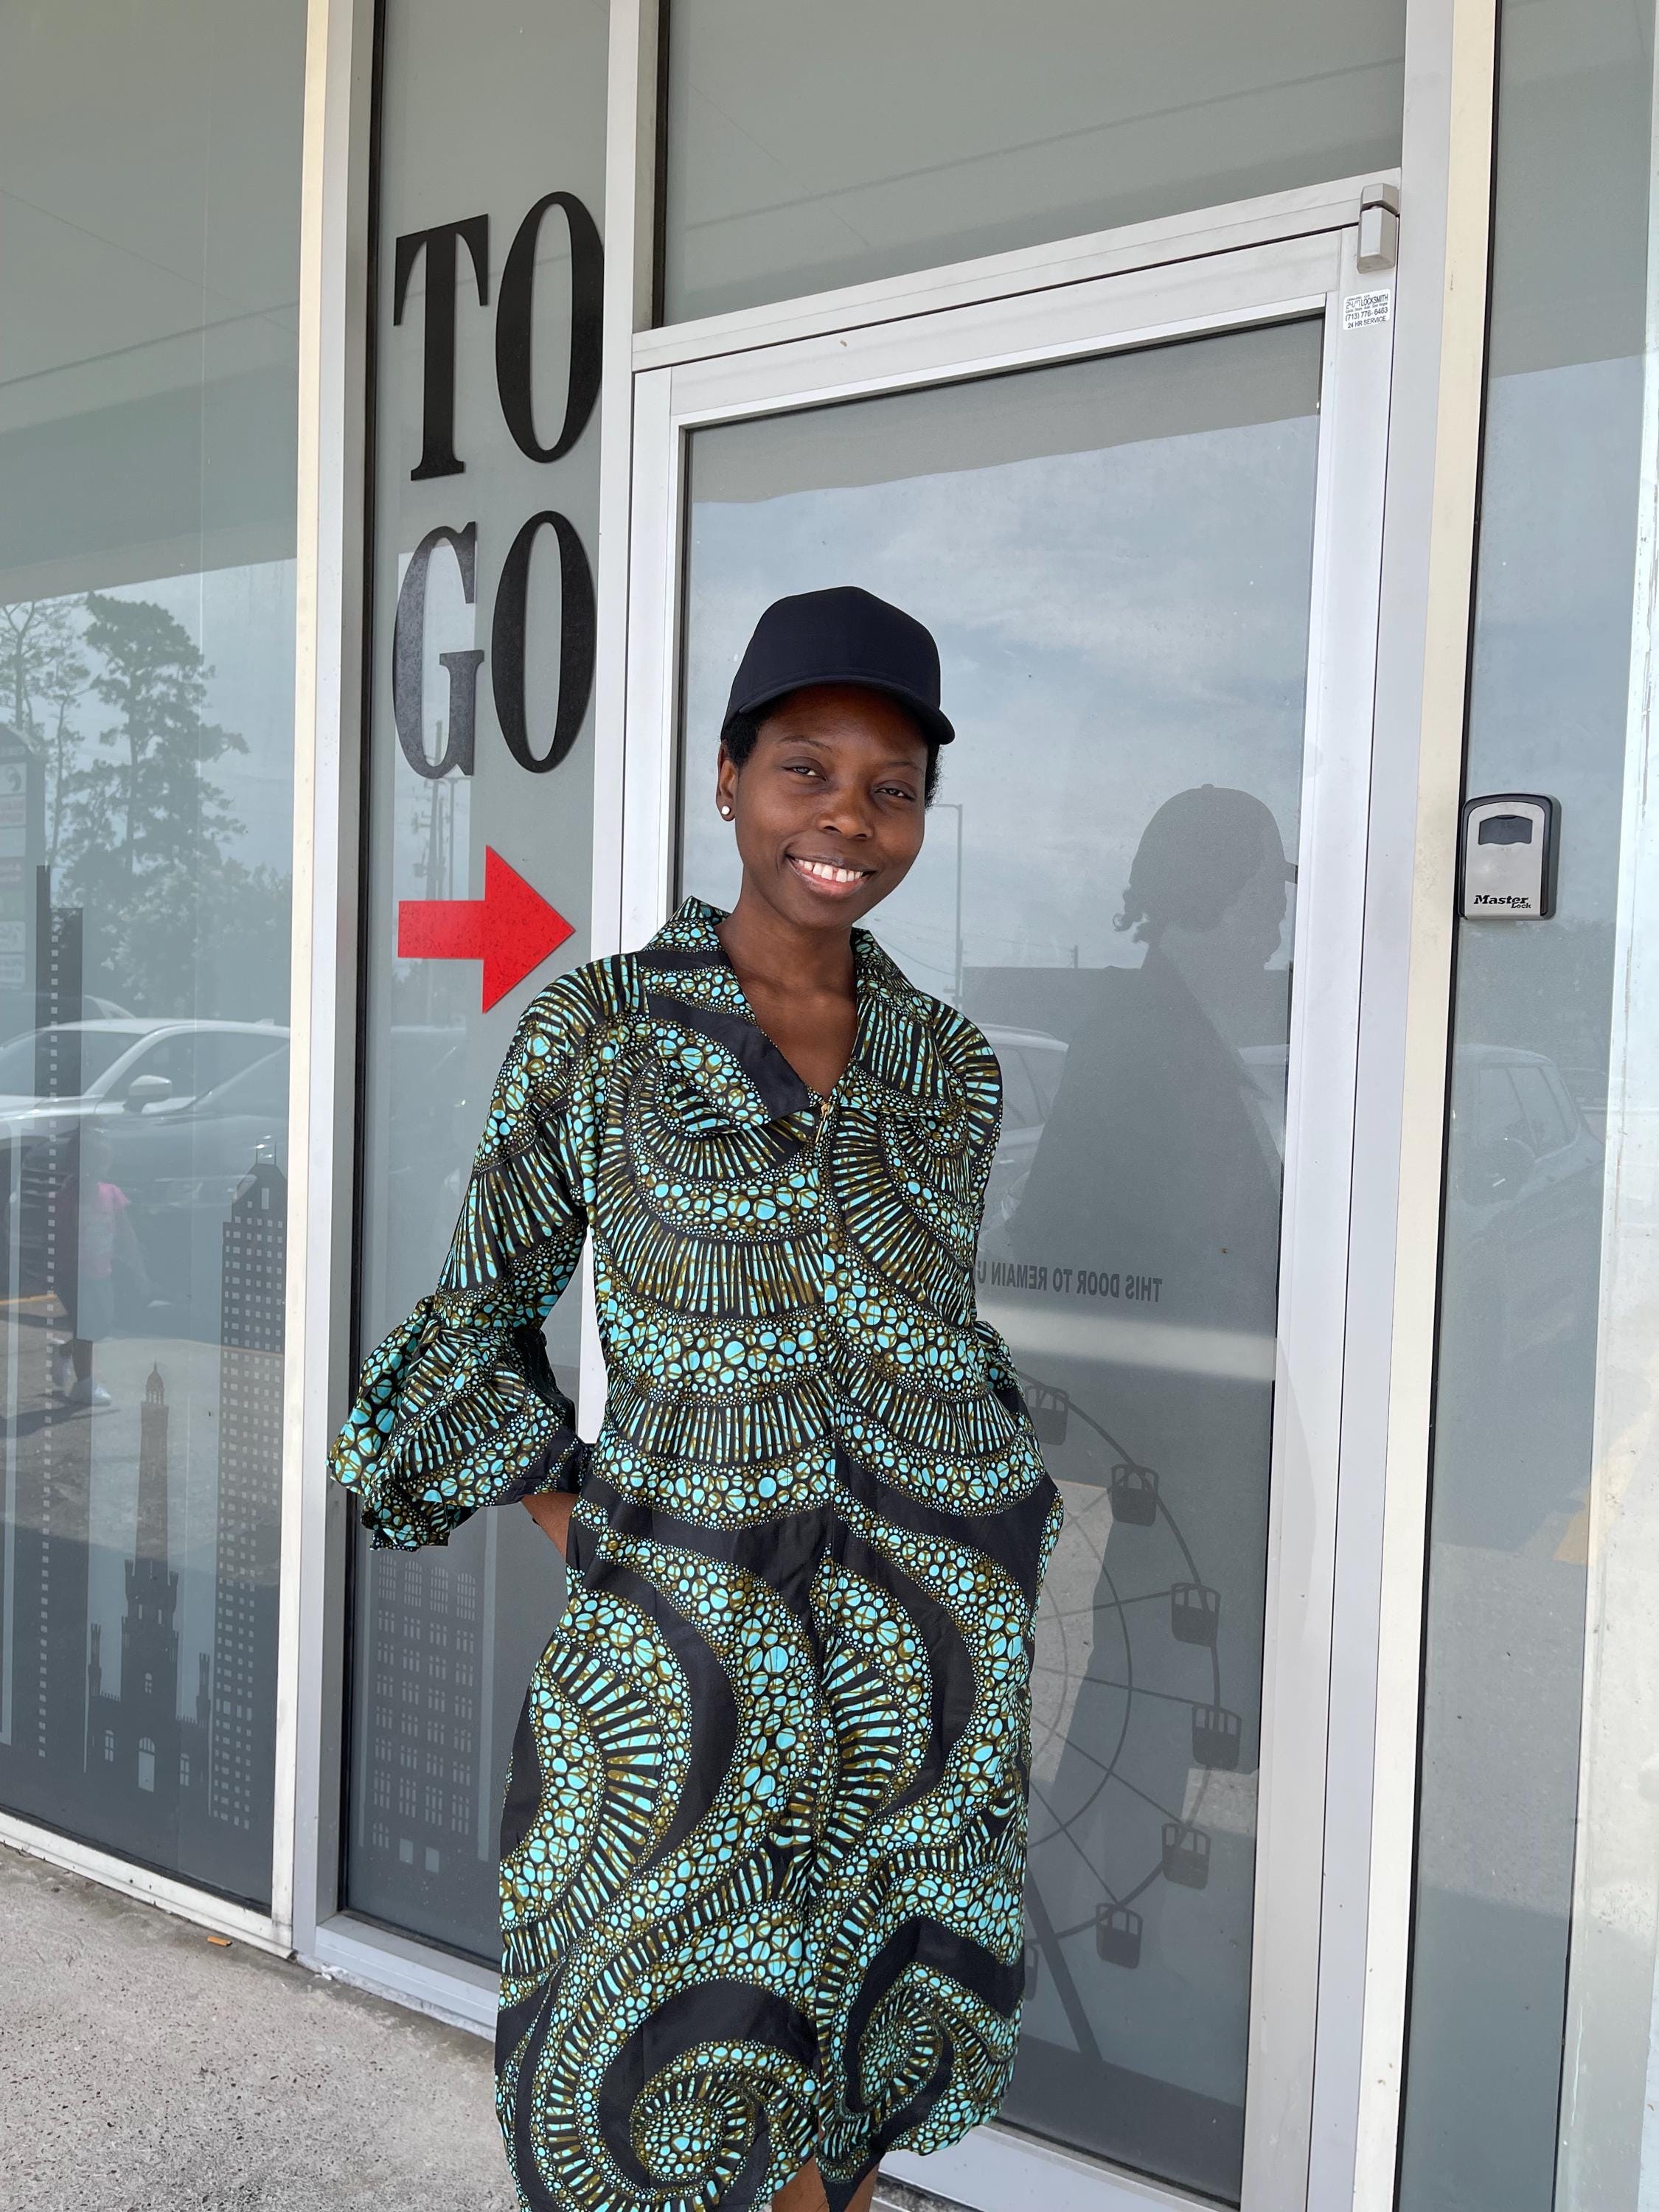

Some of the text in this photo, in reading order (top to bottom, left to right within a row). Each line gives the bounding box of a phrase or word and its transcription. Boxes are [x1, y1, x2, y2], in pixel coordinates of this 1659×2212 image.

[1360, 293, 1388, 307] LOCKSMITH
[1345, 312, 1360, 321] (713)
[1363, 315, 1387, 325] SERVICE
[393, 191, 605, 481] TO
[392, 510, 597, 779] GO
[1473, 894, 1529, 905] Master
